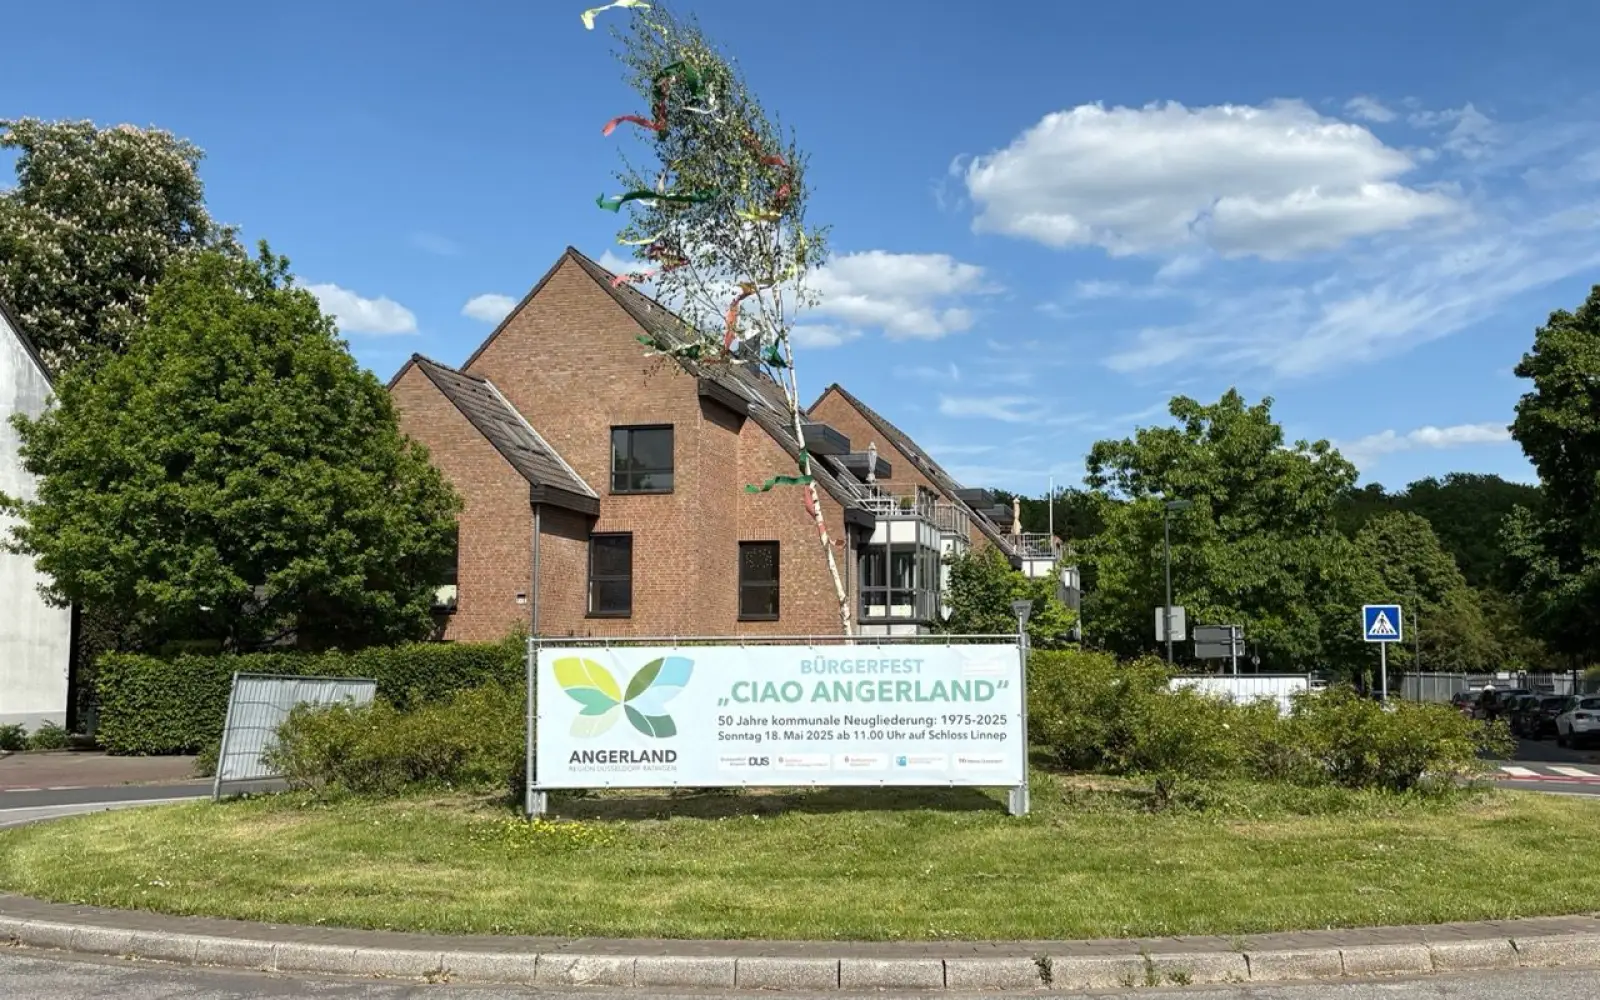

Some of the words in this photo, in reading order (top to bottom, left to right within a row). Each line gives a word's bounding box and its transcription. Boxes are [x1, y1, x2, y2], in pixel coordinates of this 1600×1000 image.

[800, 655, 924, 674] BÜRGERFEST
[717, 680, 804, 706] „CIAO
[718, 715, 733, 726] 50
[736, 715, 768, 726] Jahre
[771, 715, 841, 726] kommunale
[844, 714, 937, 728] Neugliederung:
[941, 714, 1008, 725] 1975-2025
[718, 731, 762, 743] Sonntag
[765, 731, 781, 741] 18.
[783, 731, 804, 741] Mai
[806, 730, 834, 741] 2025
[837, 730, 851, 740] ab
[854, 730, 884, 740] 11.00
[887, 730, 906, 740] Uhr
[908, 730, 926, 740] auf
[928, 729, 968, 740] Schloss
[970, 729, 1008, 743] Linnep
[569, 749, 678, 764] ANGERLAND
[748, 756, 770, 766] DUS
